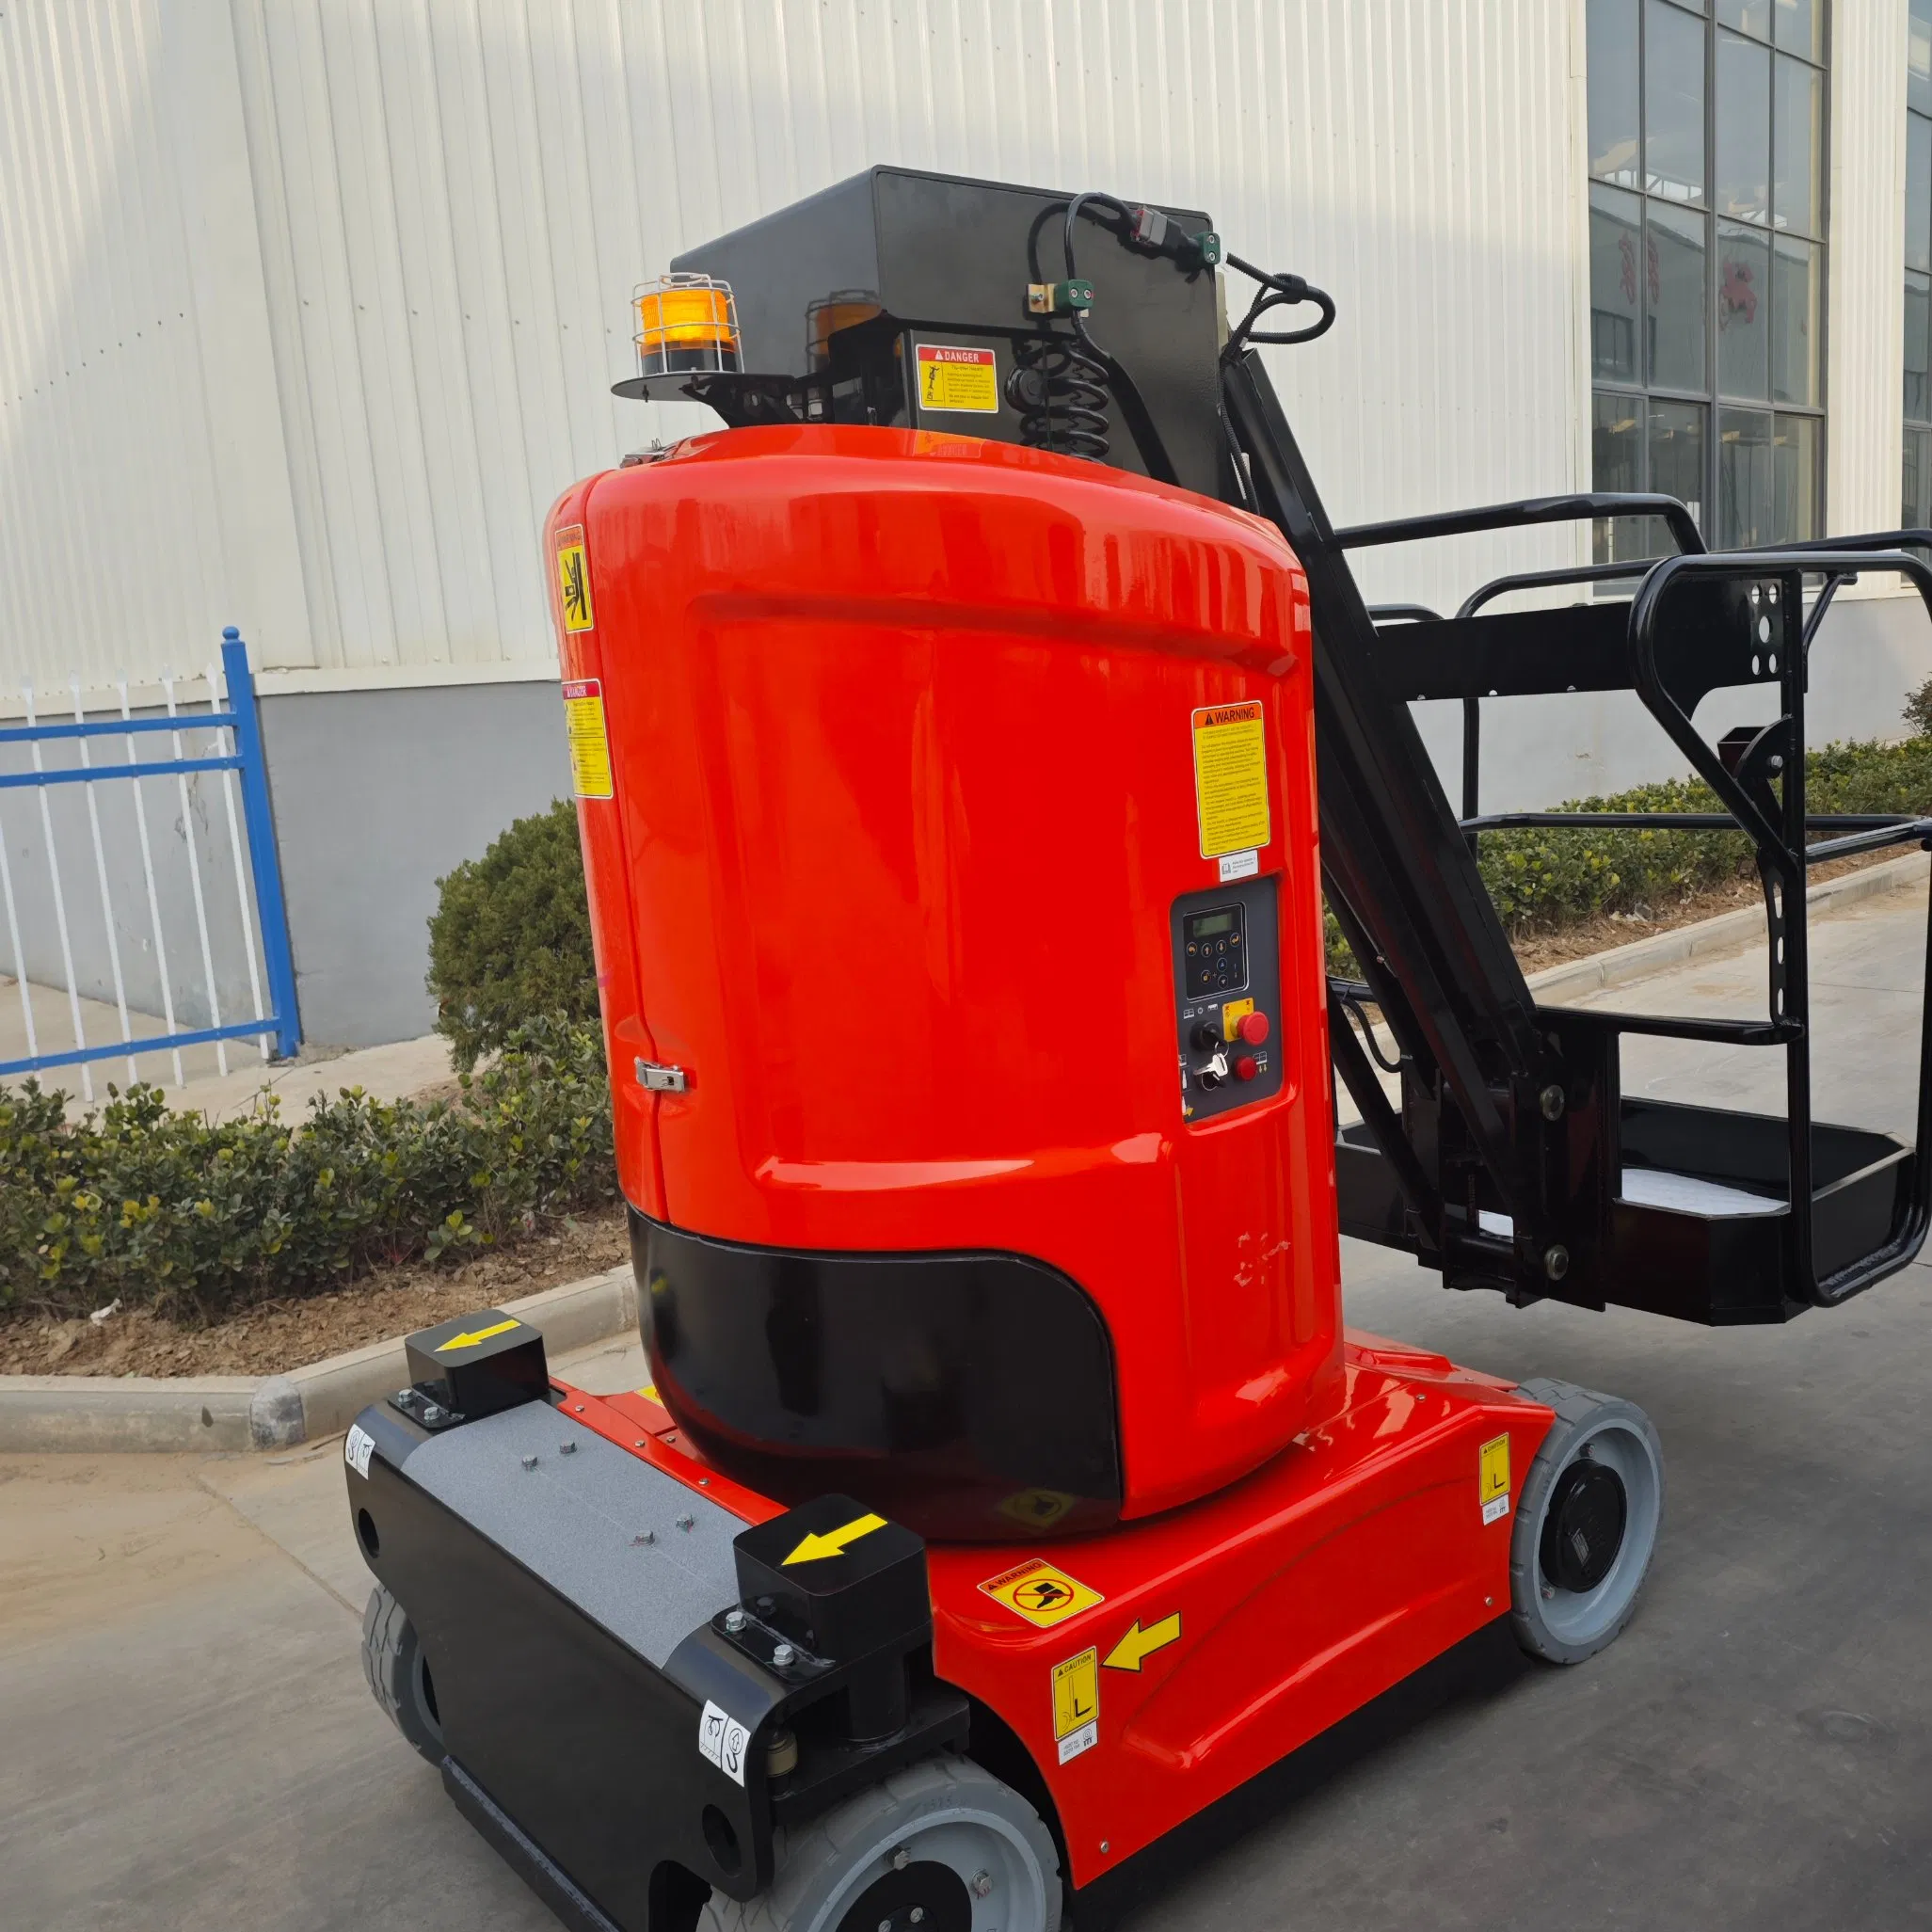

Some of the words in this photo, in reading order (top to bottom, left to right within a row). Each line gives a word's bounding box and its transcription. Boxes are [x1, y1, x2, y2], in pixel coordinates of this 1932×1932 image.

[944, 351, 980, 363] DANGER
[1215, 707, 1254, 724] WARNING
[995, 1562, 1042, 1585] WARNING
[1064, 1653, 1092, 1673] CAUTION
